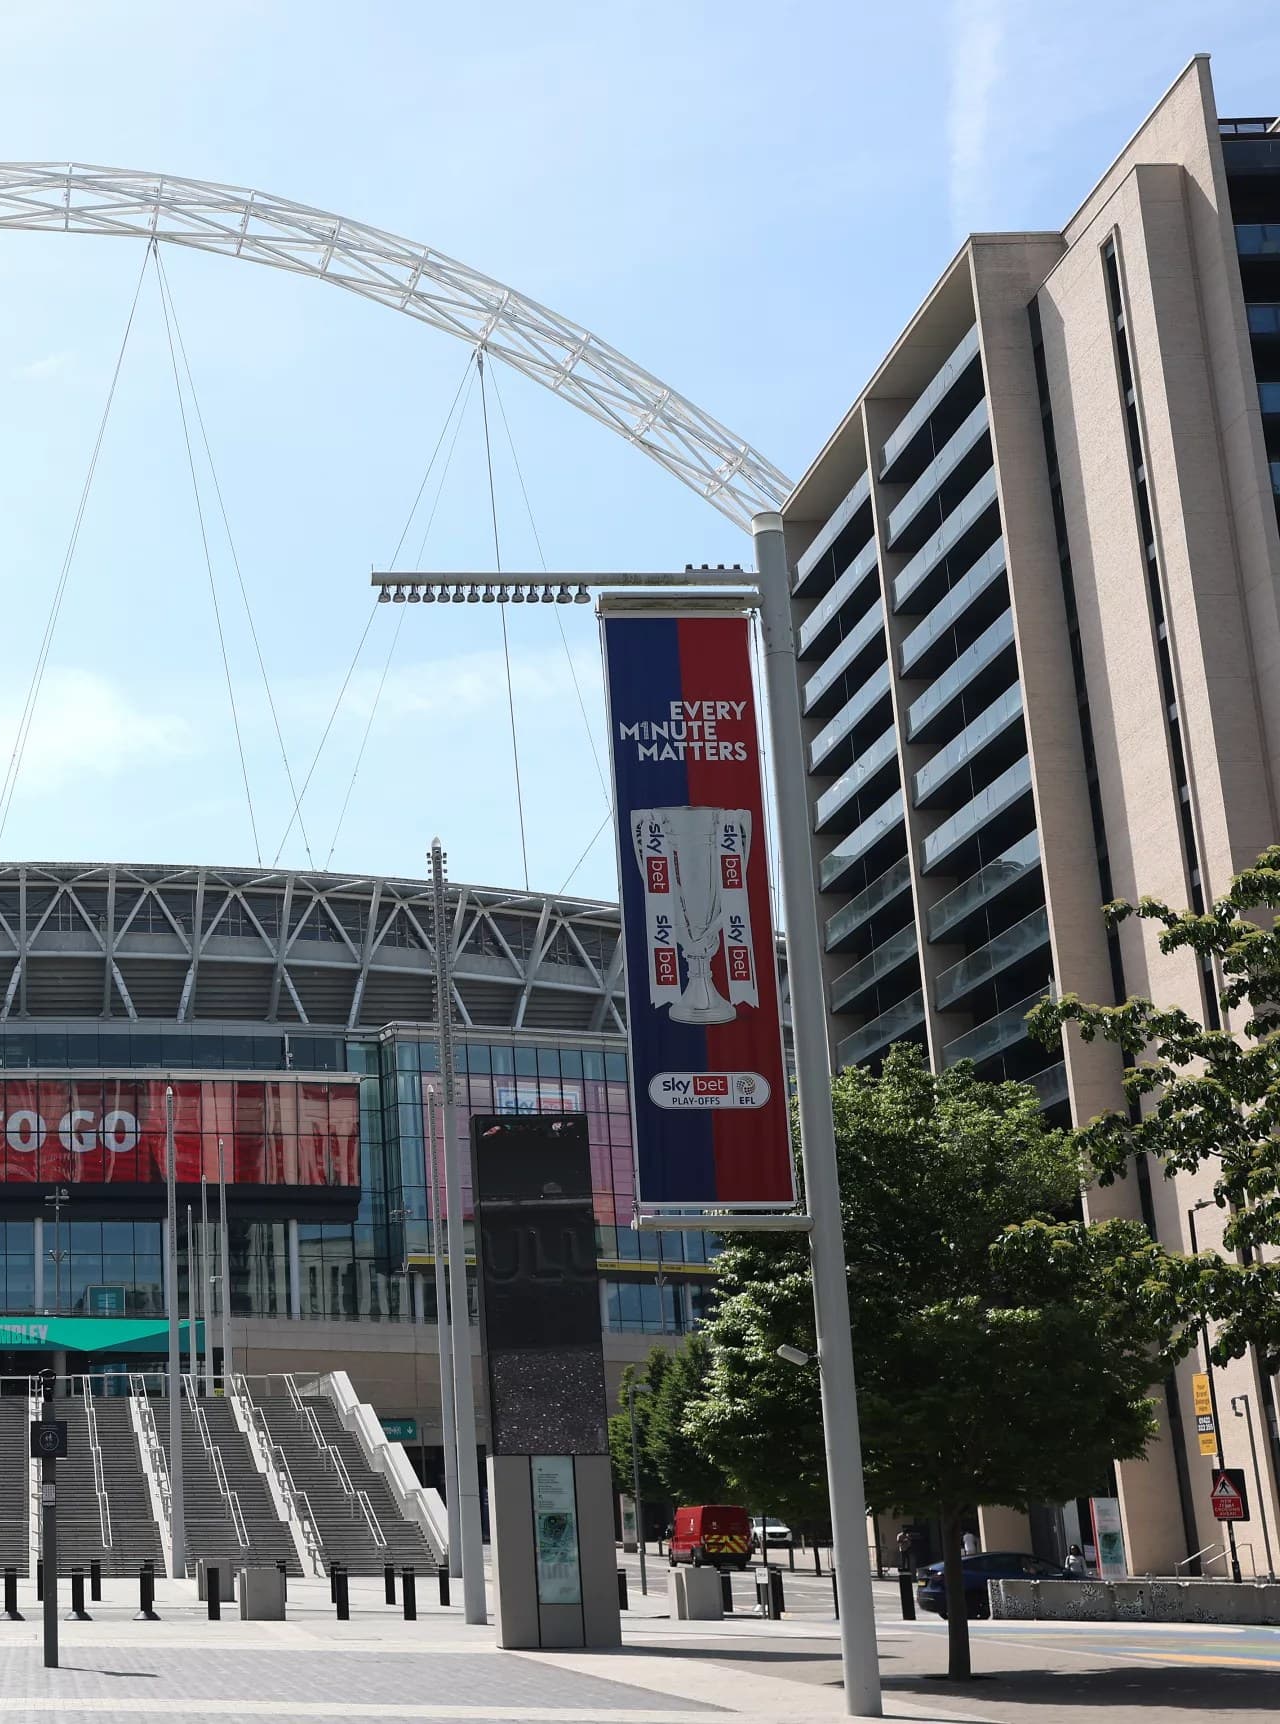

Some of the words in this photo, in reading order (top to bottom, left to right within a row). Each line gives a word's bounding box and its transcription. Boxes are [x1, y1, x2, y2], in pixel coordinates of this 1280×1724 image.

[670, 701, 747, 720] EVERY
[637, 742, 748, 761] MATTERS
[647, 823, 665, 854] sky
[721, 824, 738, 852] sky
[651, 860, 666, 890] bet
[725, 858, 739, 886] bet
[654, 915, 672, 945] sky
[728, 915, 746, 943] sky
[658, 952, 673, 983] bet
[732, 950, 747, 978] bet
[662, 1077, 691, 1095] sky
[696, 1078, 725, 1092] bet
[672, 1096, 721, 1105] PLAY-OFFS
[739, 1096, 756, 1105] EFL
[59, 1110, 142, 1152] GO
